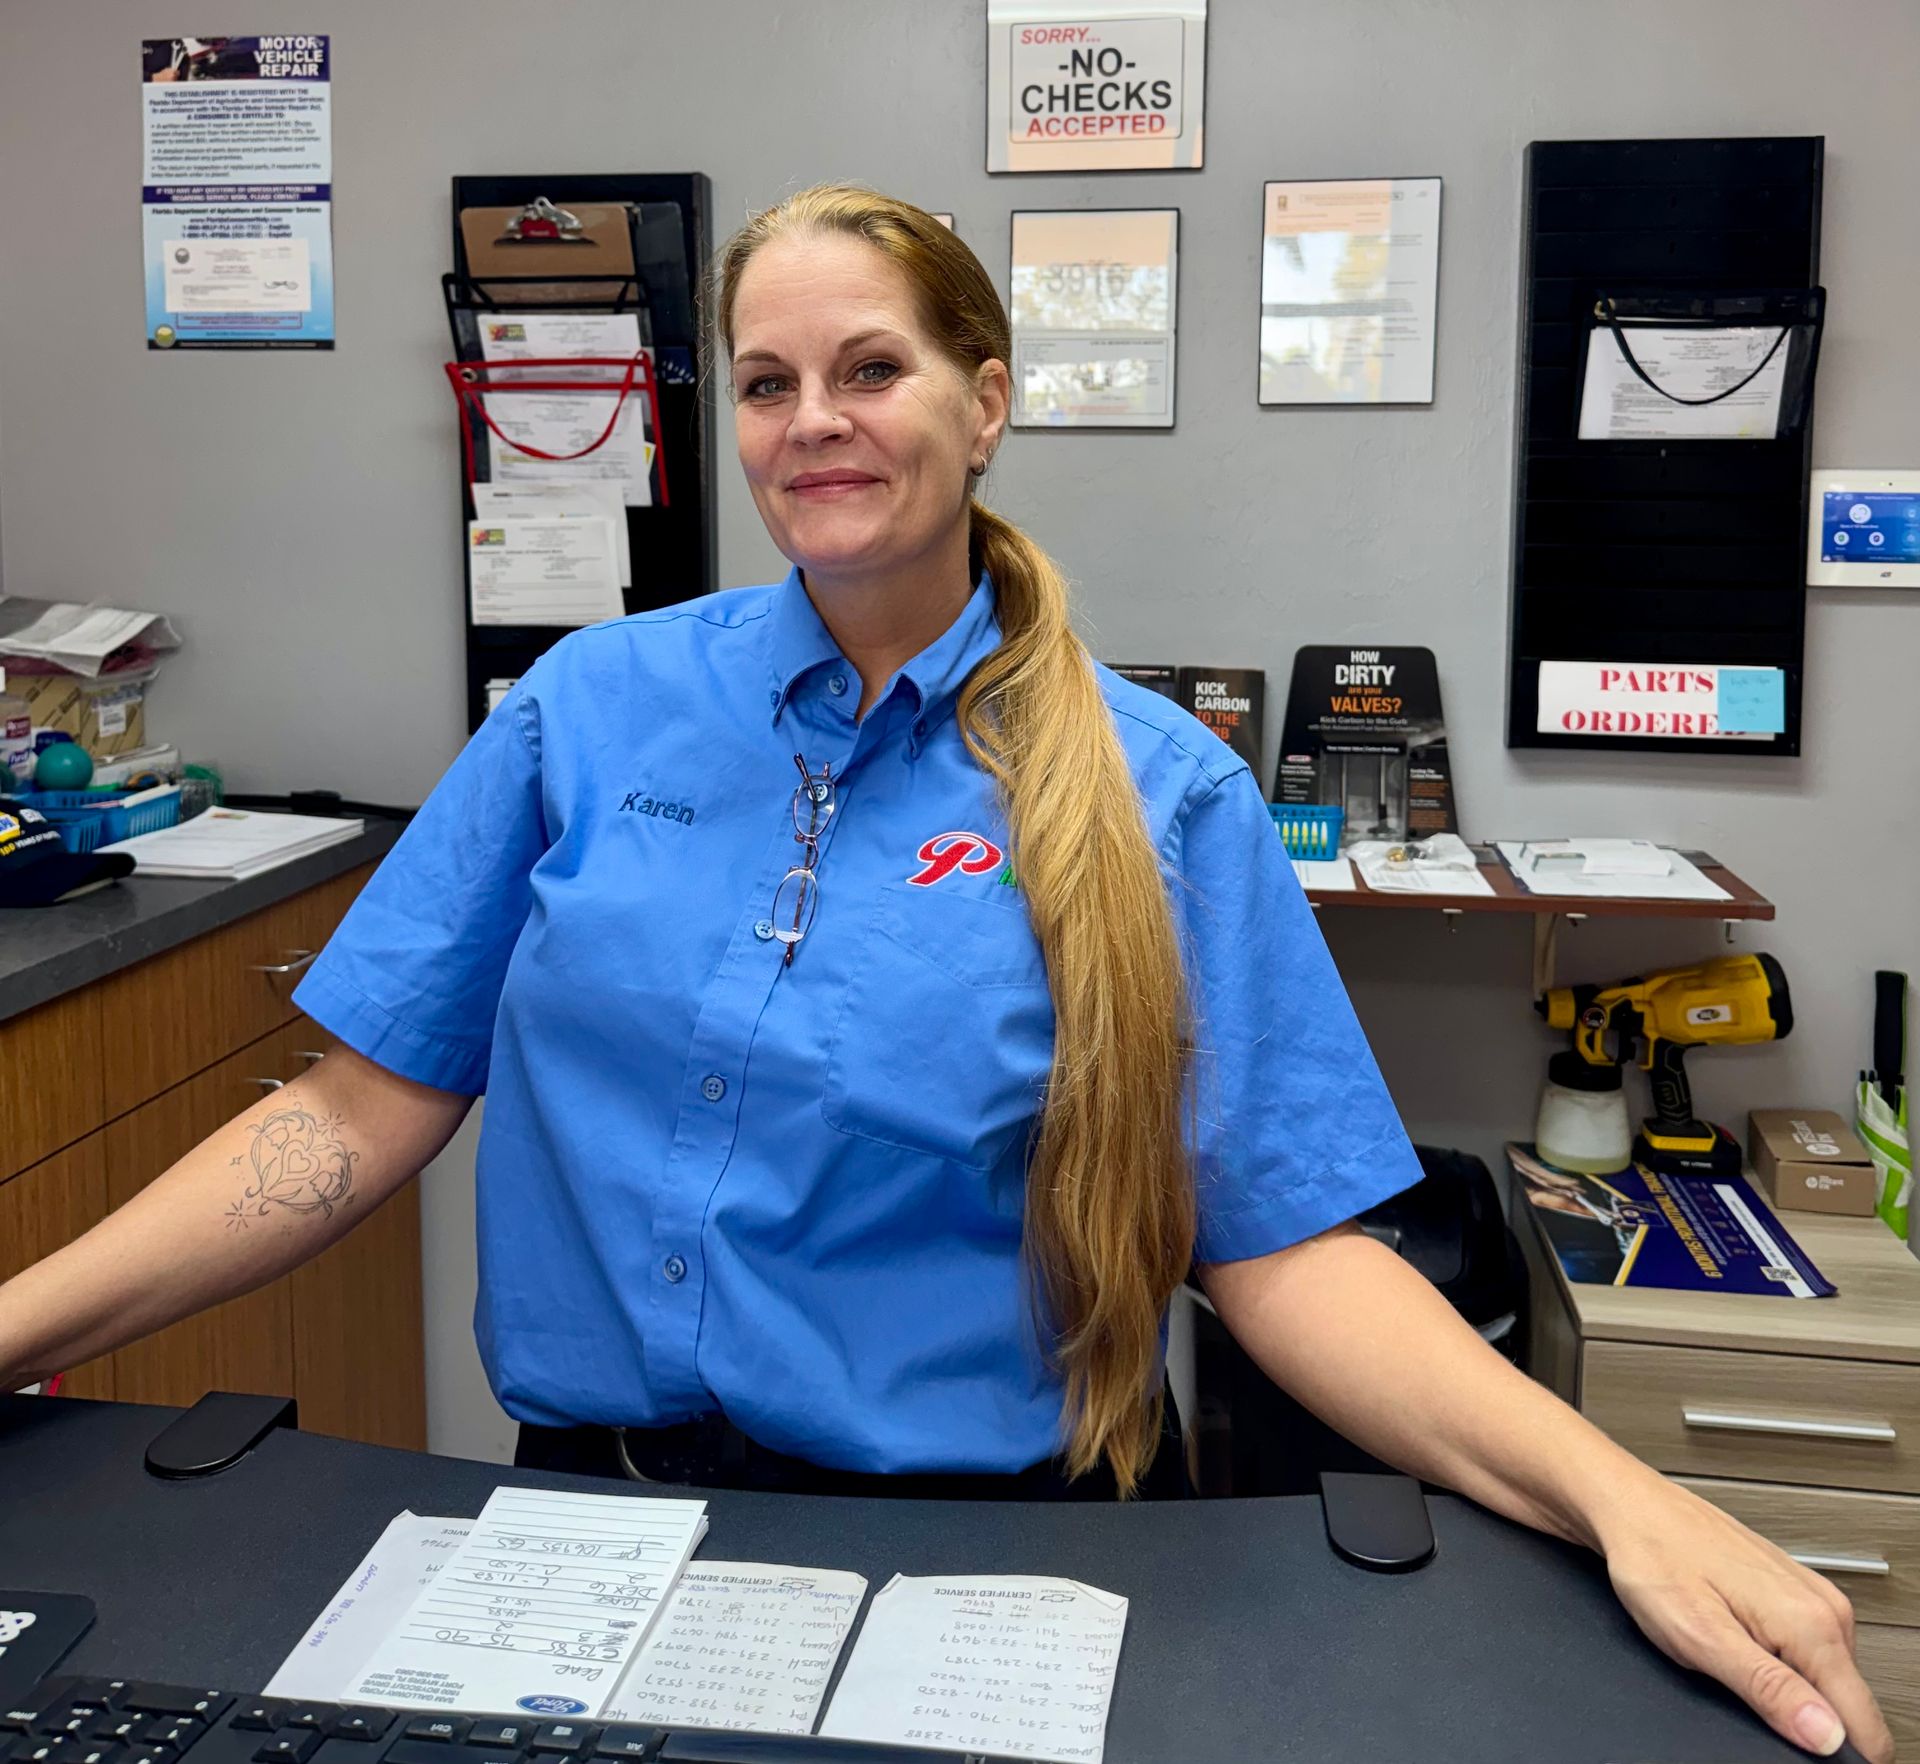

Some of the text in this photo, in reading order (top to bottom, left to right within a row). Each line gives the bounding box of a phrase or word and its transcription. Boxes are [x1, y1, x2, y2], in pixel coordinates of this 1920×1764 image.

[259, 36, 319, 51] MOTOR
[1020, 27, 1101, 44] SORRY...
[253, 50, 324, 64] VEHICLE
[1058, 47, 1136, 78] -NO-
[259, 63, 319, 77] REPAIR
[1020, 80, 1172, 113] CHECKS
[1026, 114, 1165, 137] ACCEPTED
[1350, 650, 1380, 664] HOW
[1335, 664, 1396, 686] DIRTY
[1600, 670, 1714, 693] PARTS
[1195, 681, 1228, 696] KICK
[1194, 696, 1250, 712] CARBON
[1331, 696, 1403, 714] VALVES?
[1215, 712, 1240, 726] THE
[1561, 711, 1746, 736] ORDERE
[618, 792, 695, 826] Karen
[440, 1529, 471, 1537] RVICE
[679, 1573, 774, 1586] CERTIFIED SERVIC
[932, 1586, 977, 1598] SERVICE
[979, 1588, 1032, 1600] CERTIFIED
[552, 1664, 603, 1681] REAR
[530, 1696, 575, 1713] Ford
[431, 1723, 453, 1734] Ctrl
